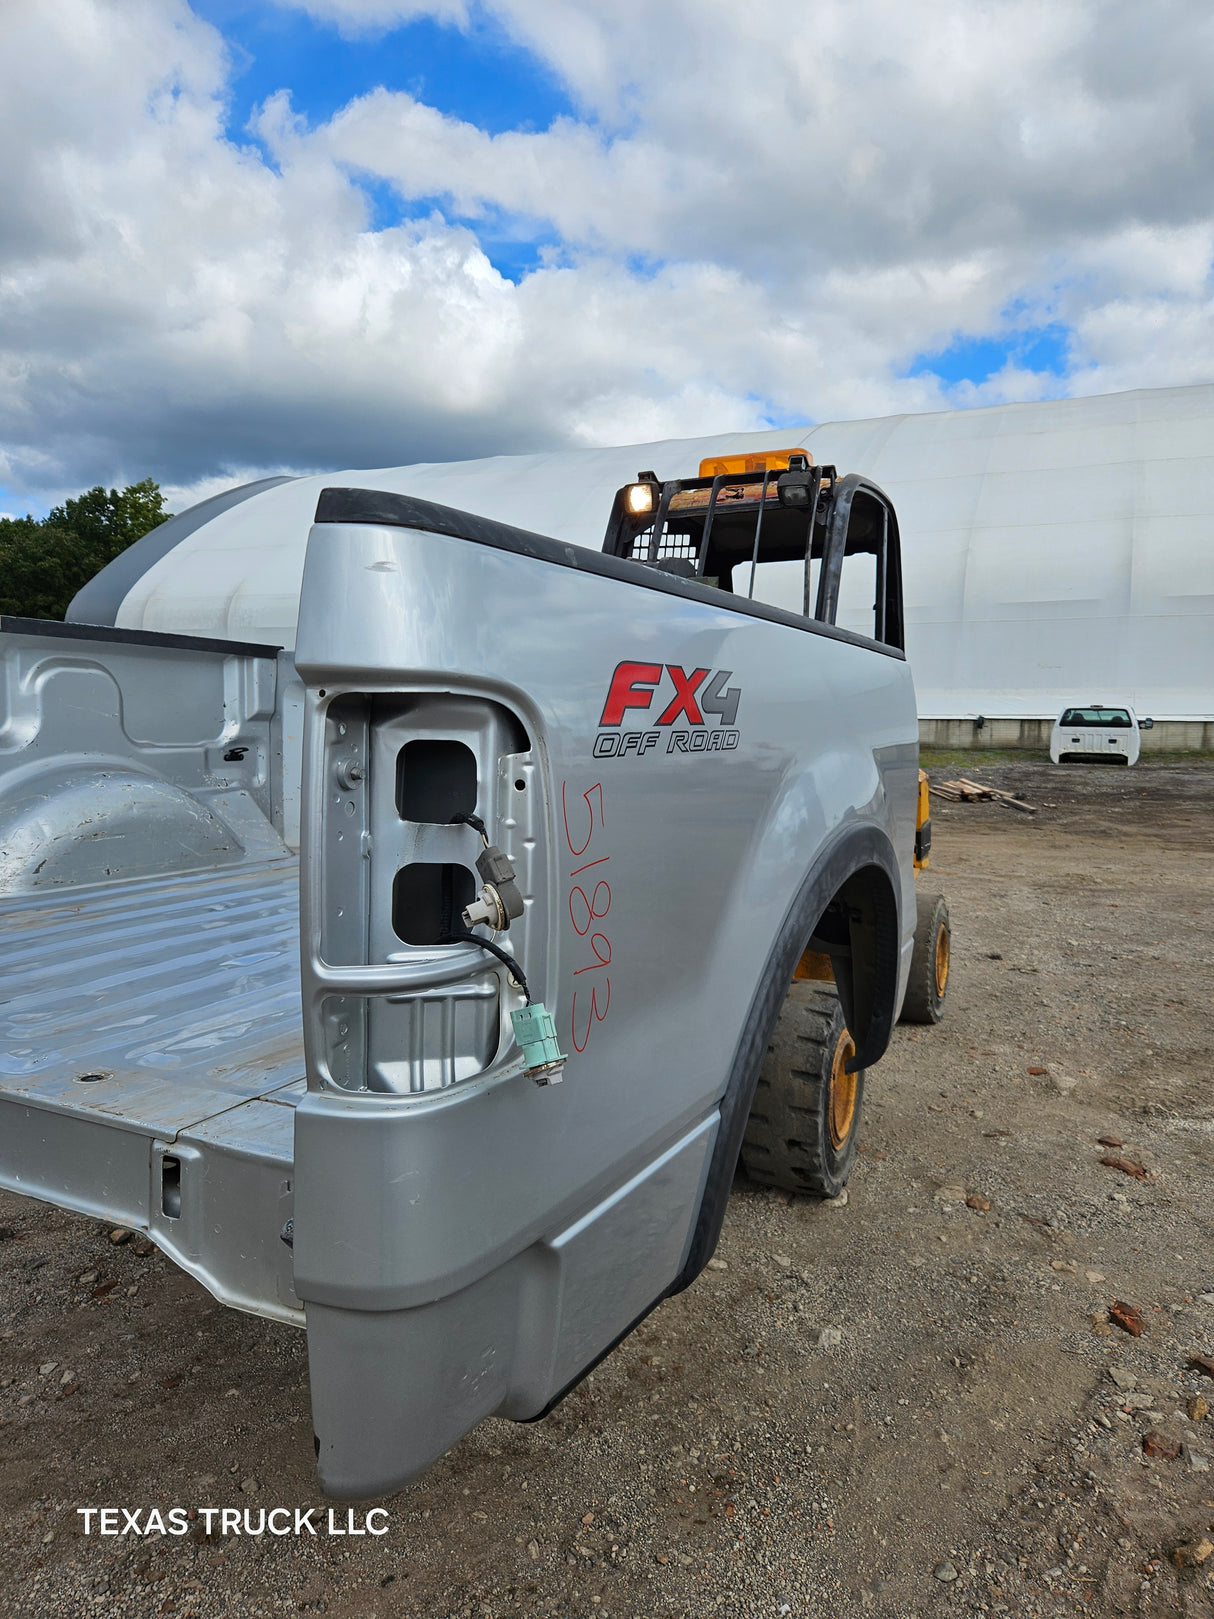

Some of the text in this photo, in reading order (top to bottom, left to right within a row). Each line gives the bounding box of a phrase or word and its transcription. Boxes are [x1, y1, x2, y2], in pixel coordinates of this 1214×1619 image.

[598, 660, 742, 728] FX4
[592, 730, 741, 759] OFF ROAD
[562, 780, 612, 1053] 51893
